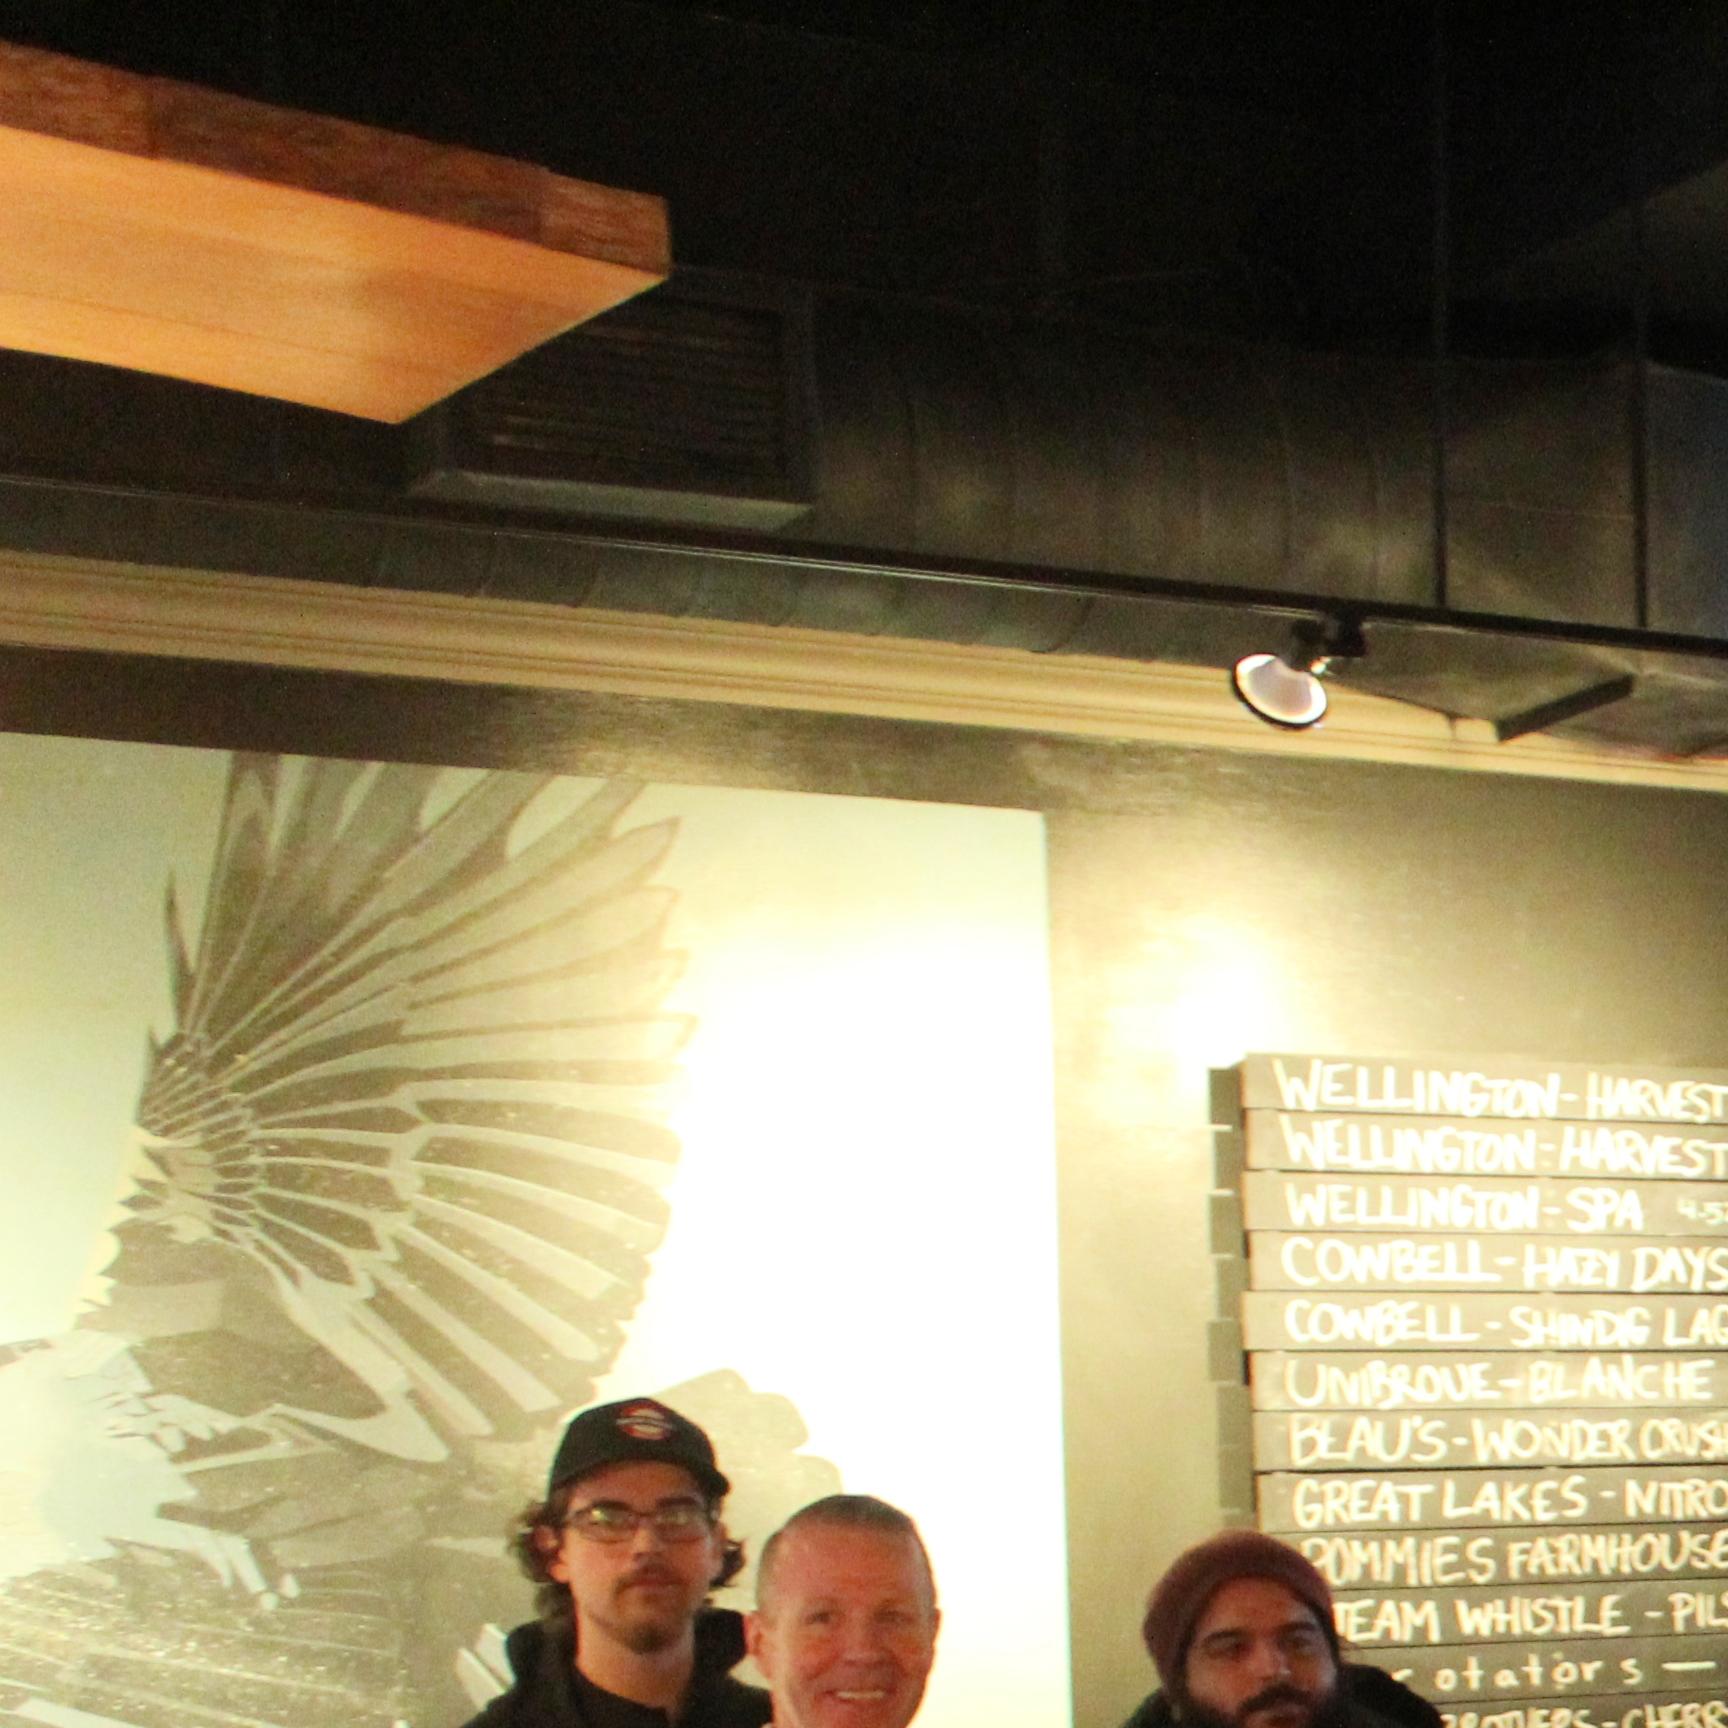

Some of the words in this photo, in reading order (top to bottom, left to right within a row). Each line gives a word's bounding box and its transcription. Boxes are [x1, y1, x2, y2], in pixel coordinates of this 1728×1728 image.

[1272, 1057, 1560, 1118] WELLINGTON
[1279, 1115, 1536, 1172] WELLINGTON
[1285, 1182, 1539, 1229] WELLINGTON
[1565, 1186, 1644, 1233] SPA
[1281, 1236, 1502, 1286] COWBELL
[1522, 1244, 1619, 1289] HAZY
[1284, 1299, 1481, 1346] COWBELL
[1509, 1305, 1650, 1348] SHINDIG
[1284, 1358, 1501, 1409] UNIBROUE
[1528, 1354, 1716, 1403] BLANCHE
[1290, 1414, 1448, 1467] BEAU'S
[1471, 1417, 1636, 1464] WONDER
[1292, 1479, 1435, 1528] GREAT
[1442, 1475, 1588, 1521] LAKES
[1300, 1535, 1496, 1587] POMMIES
[1332, 1598, 1441, 1644] TEAM
[1456, 1595, 1631, 1637] WHISTLE
